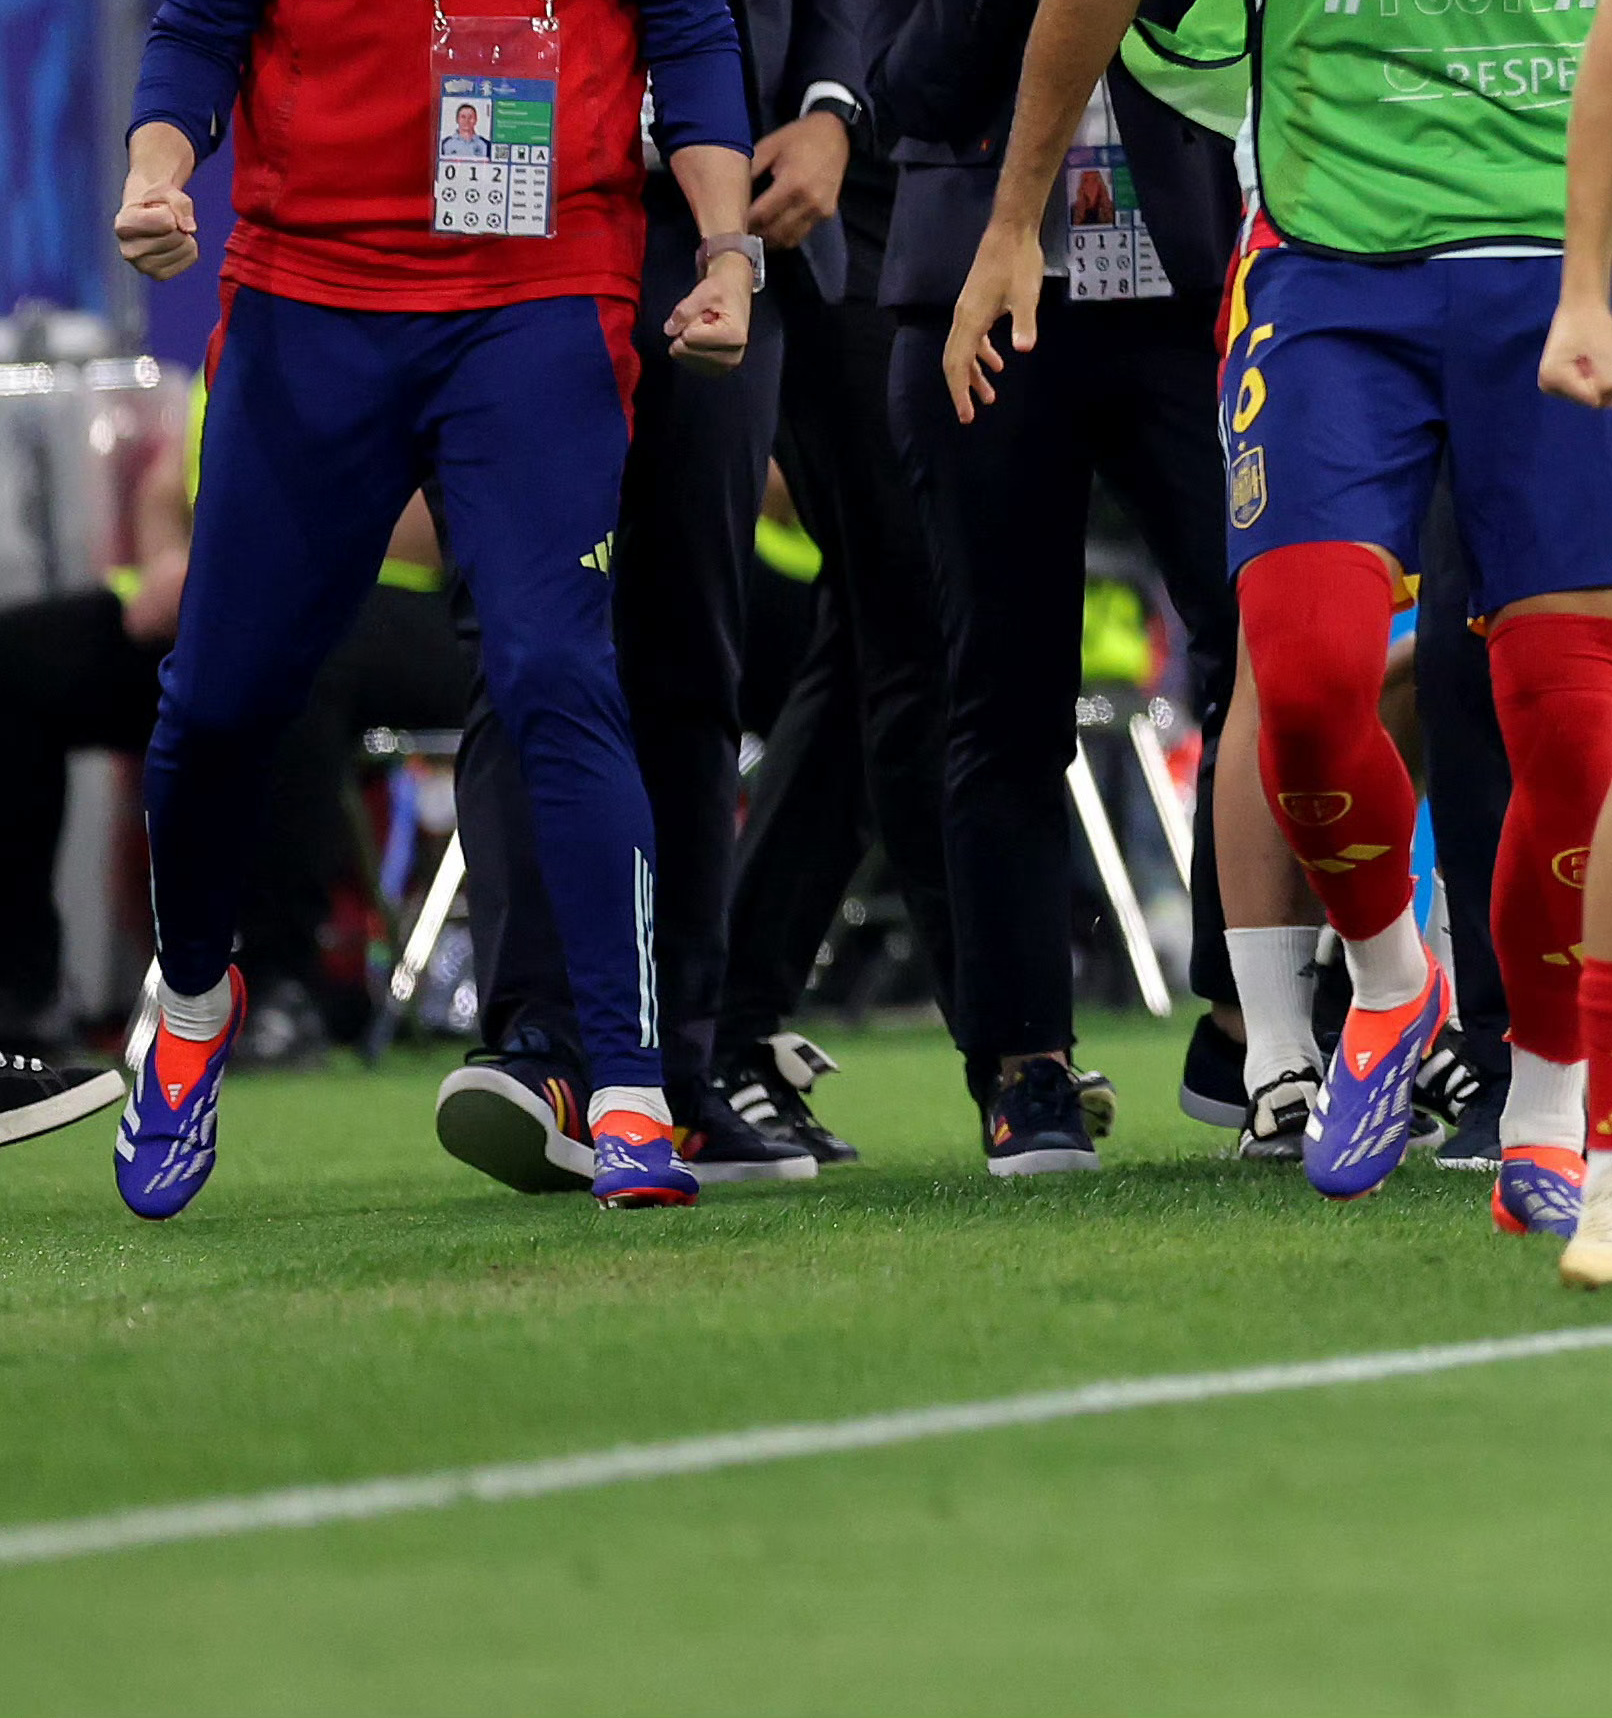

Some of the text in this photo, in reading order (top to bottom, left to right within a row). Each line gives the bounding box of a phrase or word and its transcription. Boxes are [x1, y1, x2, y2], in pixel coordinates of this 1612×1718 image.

[444, 165, 502, 183] 0 1 2
[442, 210, 453, 227] 6
